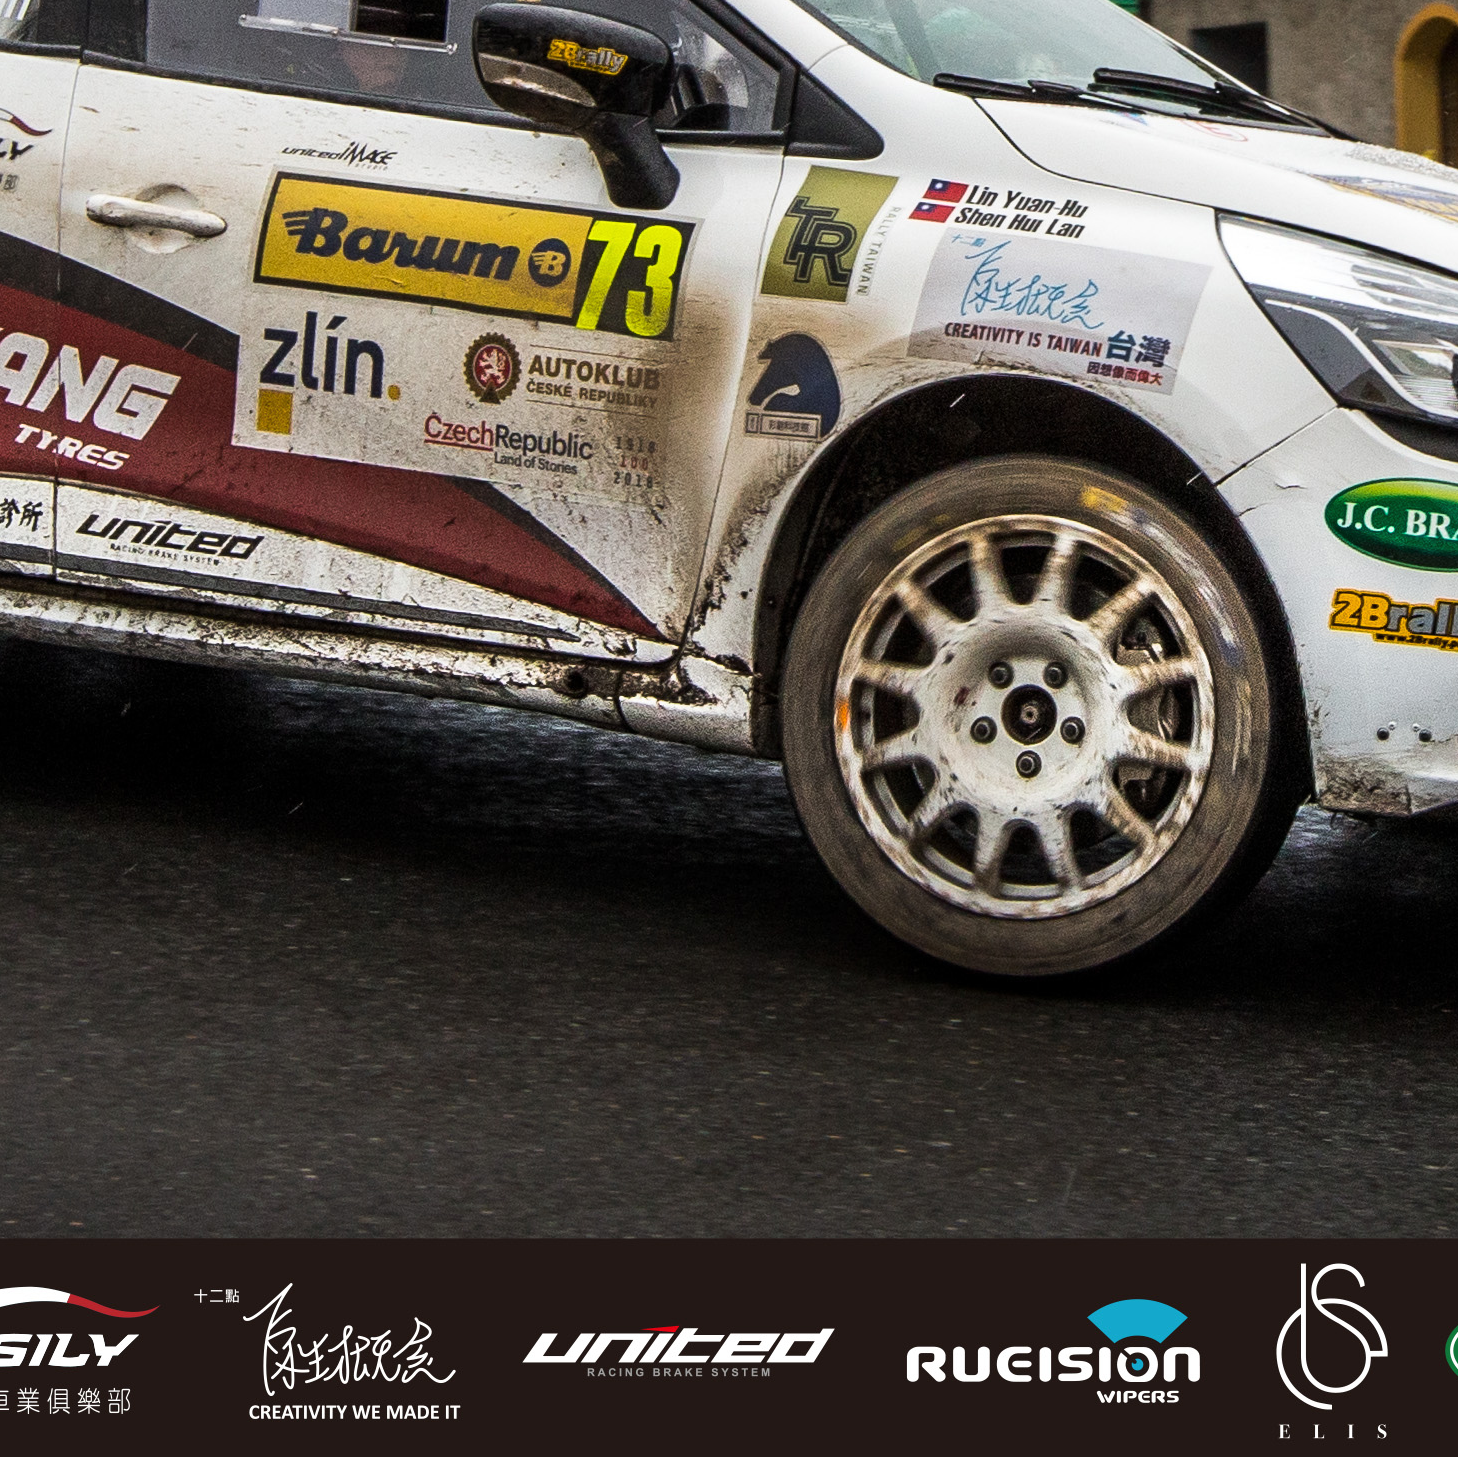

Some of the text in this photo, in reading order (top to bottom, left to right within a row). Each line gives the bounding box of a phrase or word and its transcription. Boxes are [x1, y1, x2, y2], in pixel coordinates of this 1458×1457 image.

[966, 185, 1089, 219] Lin Yuan-Hu
[954, 207, 1005, 228] Shen
[1045, 217, 1086, 239] Lan
[281, 207, 520, 282] Barum
[857, 206, 901, 297] RALLY TAIWAN
[575, 220, 683, 338] 73
[945, 322, 1103, 358] CREATIVITY IS TAIWAN
[1106, 329, 1171, 369] 台灣
[528, 355, 660, 390] AUTOKLUB
[526, 378, 658, 409] ČESKÉ REPUBLIKY
[14, 424, 130, 470] TYRES
[494, 452, 578, 476] Land of Stories
[1337, 502, 1395, 534] J.C.
[76, 514, 265, 560] united
